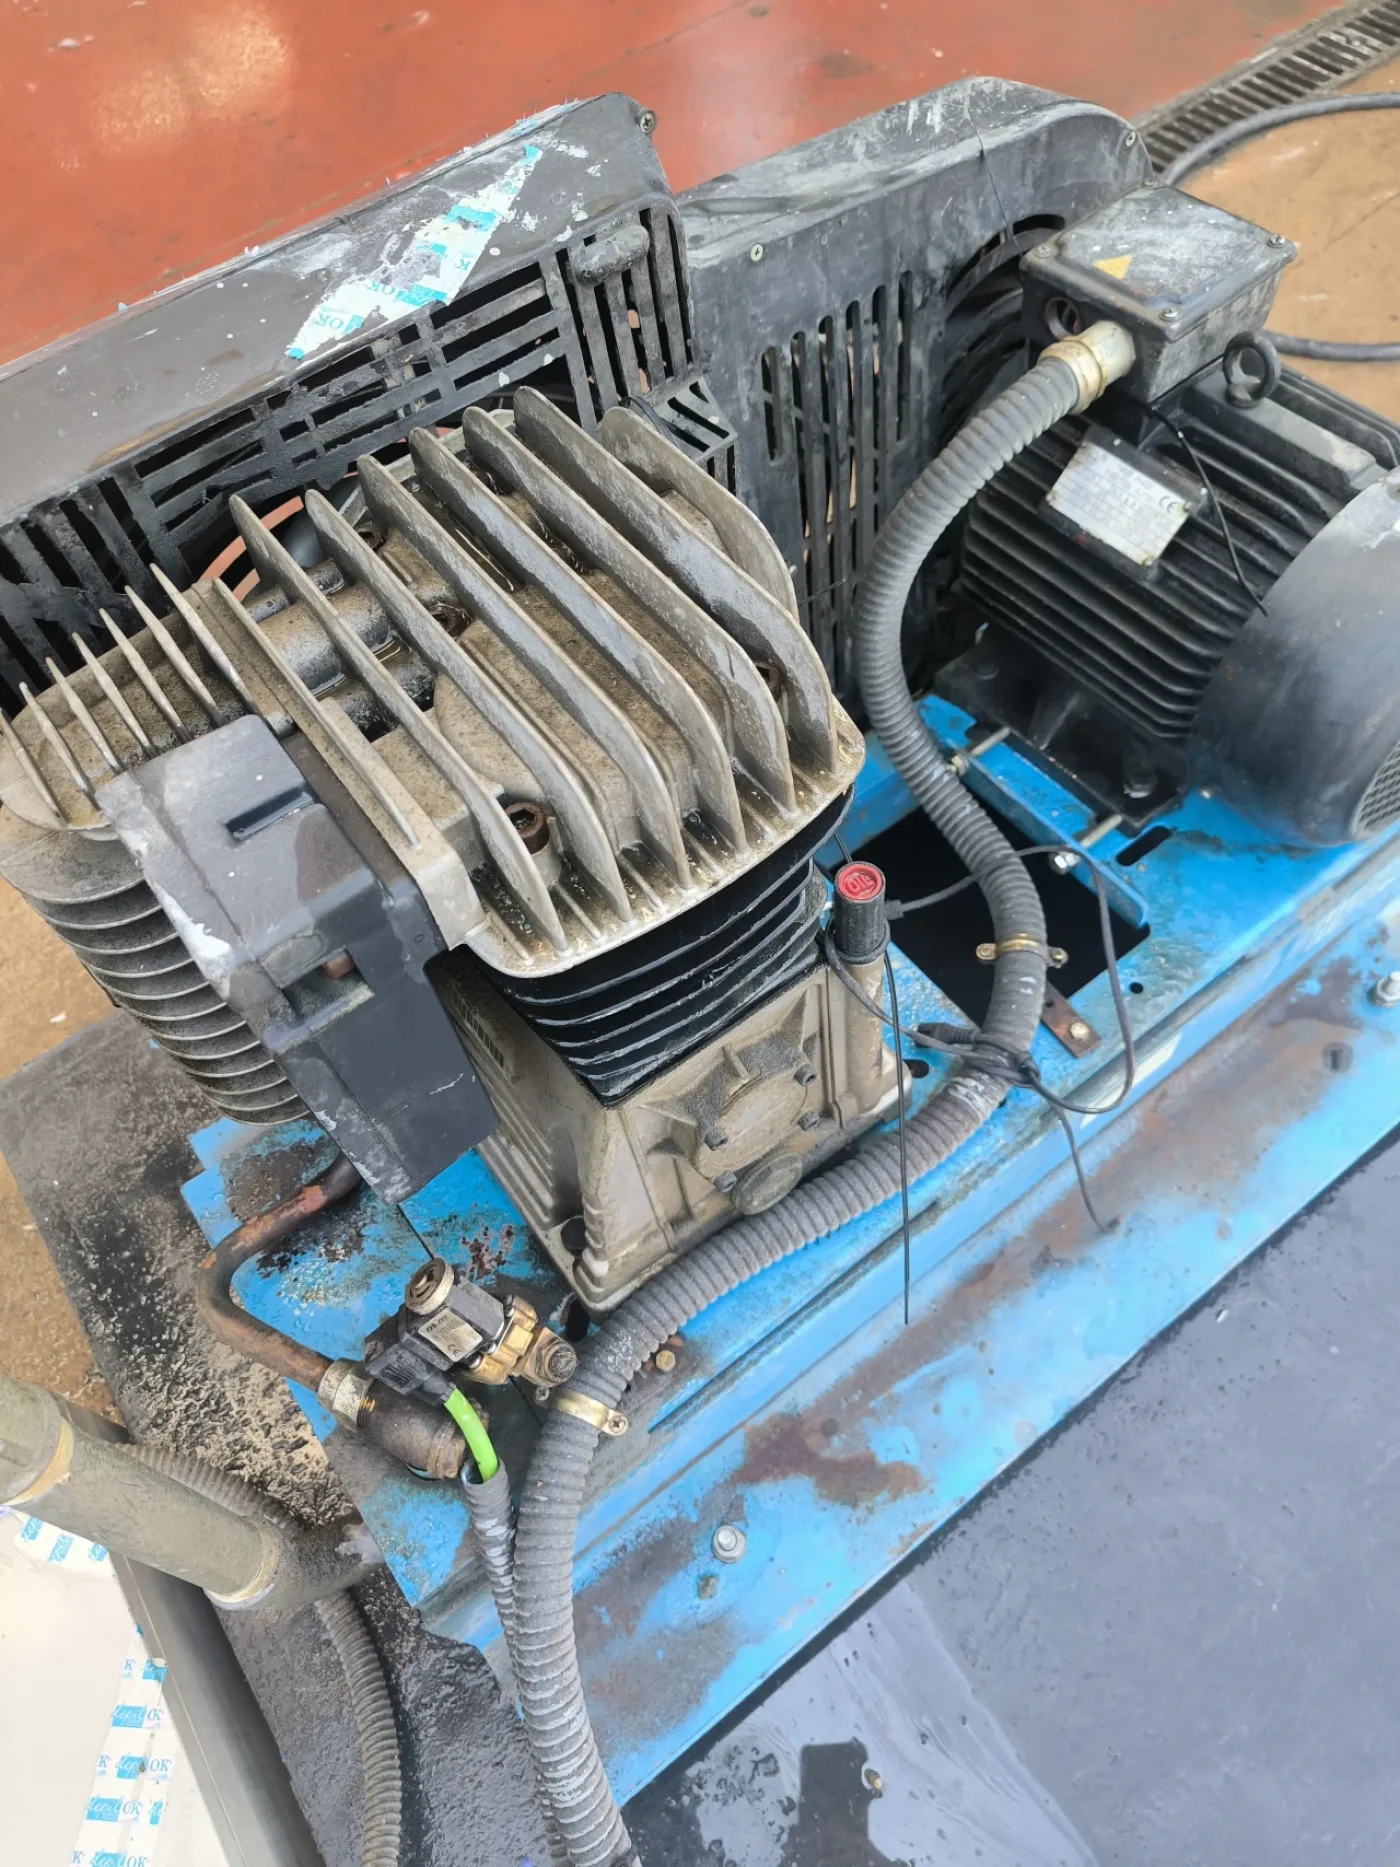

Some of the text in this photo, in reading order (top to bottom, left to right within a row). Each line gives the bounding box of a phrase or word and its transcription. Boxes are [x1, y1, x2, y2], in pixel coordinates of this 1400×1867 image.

[312, 312, 345, 330] OK
[846, 874, 875, 892] OIL
[150, 1759, 172, 1772] OK
